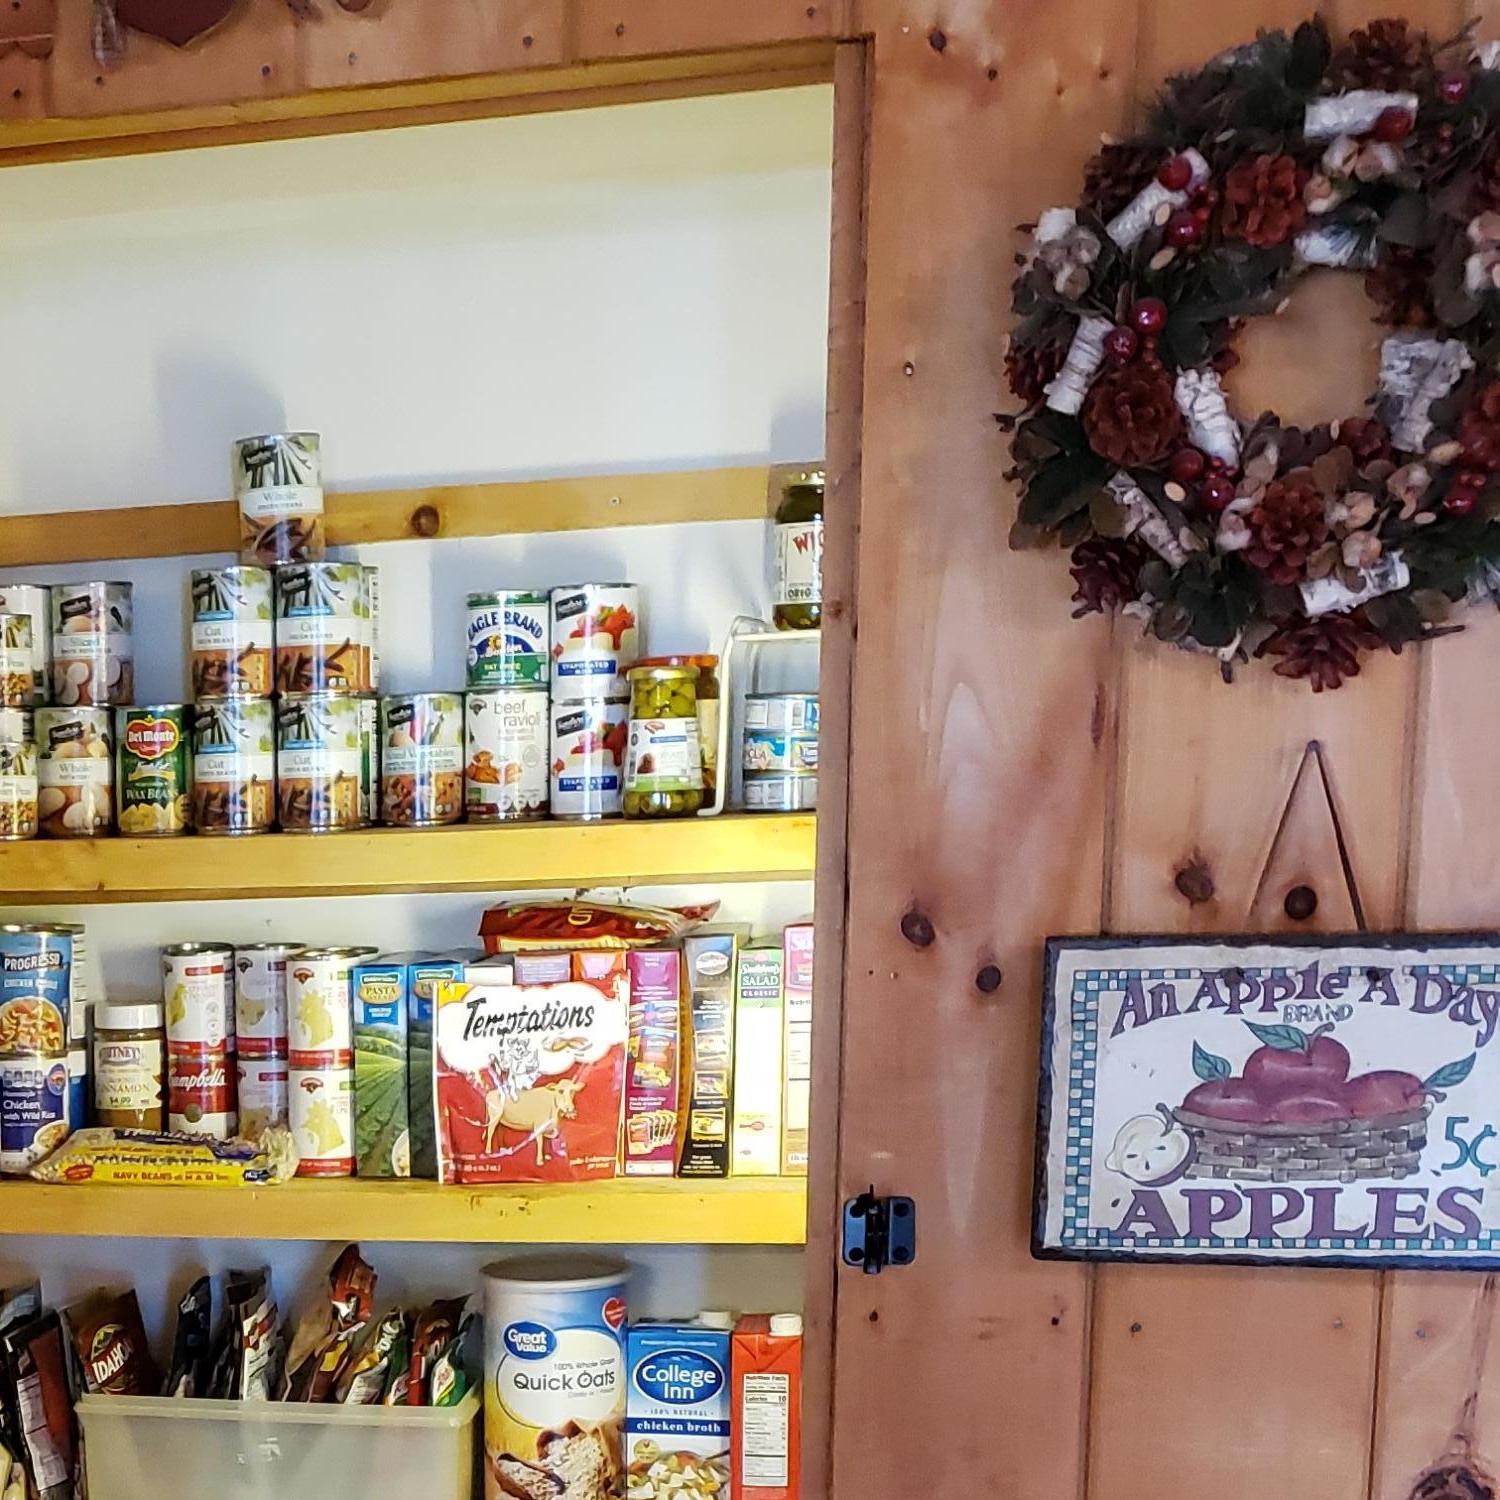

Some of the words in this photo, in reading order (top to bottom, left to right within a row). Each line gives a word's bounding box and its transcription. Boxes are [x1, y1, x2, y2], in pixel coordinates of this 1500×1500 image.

[468, 611, 499, 642] EAGLE
[503, 611, 544, 640] BRAND
[493, 699, 527, 716] beef
[503, 711, 541, 727] ravioli
[128, 731, 143, 743] Del
[144, 730, 175, 743] Monte
[207, 760, 225, 769] Cut
[294, 756, 311, 766] Cut
[3, 952, 62, 971] PROGRESSO
[741, 975, 779, 986] SALAD
[365, 986, 396, 996] PASTA
[1110, 975, 1182, 1039] An
[1184, 960, 1348, 1014] Apple
[1358, 967, 1401, 1006] A
[1409, 967, 1500, 1048] Day
[463, 996, 596, 1043] Temptations
[1282, 1002, 1354, 1024] BRAND
[2, 1100, 41, 1111] Chicken
[21, 1110, 41, 1120] Wild
[112, 1171, 139, 1181] NAVY
[140, 1172, 172, 1181] BEANS
[1108, 1186, 1486, 1240] APPLES
[507, 1328, 548, 1346] Great
[516, 1341, 547, 1353] Value
[513, 1371, 573, 1392] Quick
[579, 1370, 616, 1390] Oats
[642, 1365, 717, 1388] College
[663, 1383, 695, 1400] Inn
[673, 1408, 709, 1417] NATURAL
[636, 1421, 685, 1432] chicken
[687, 1421, 722, 1433] broth
